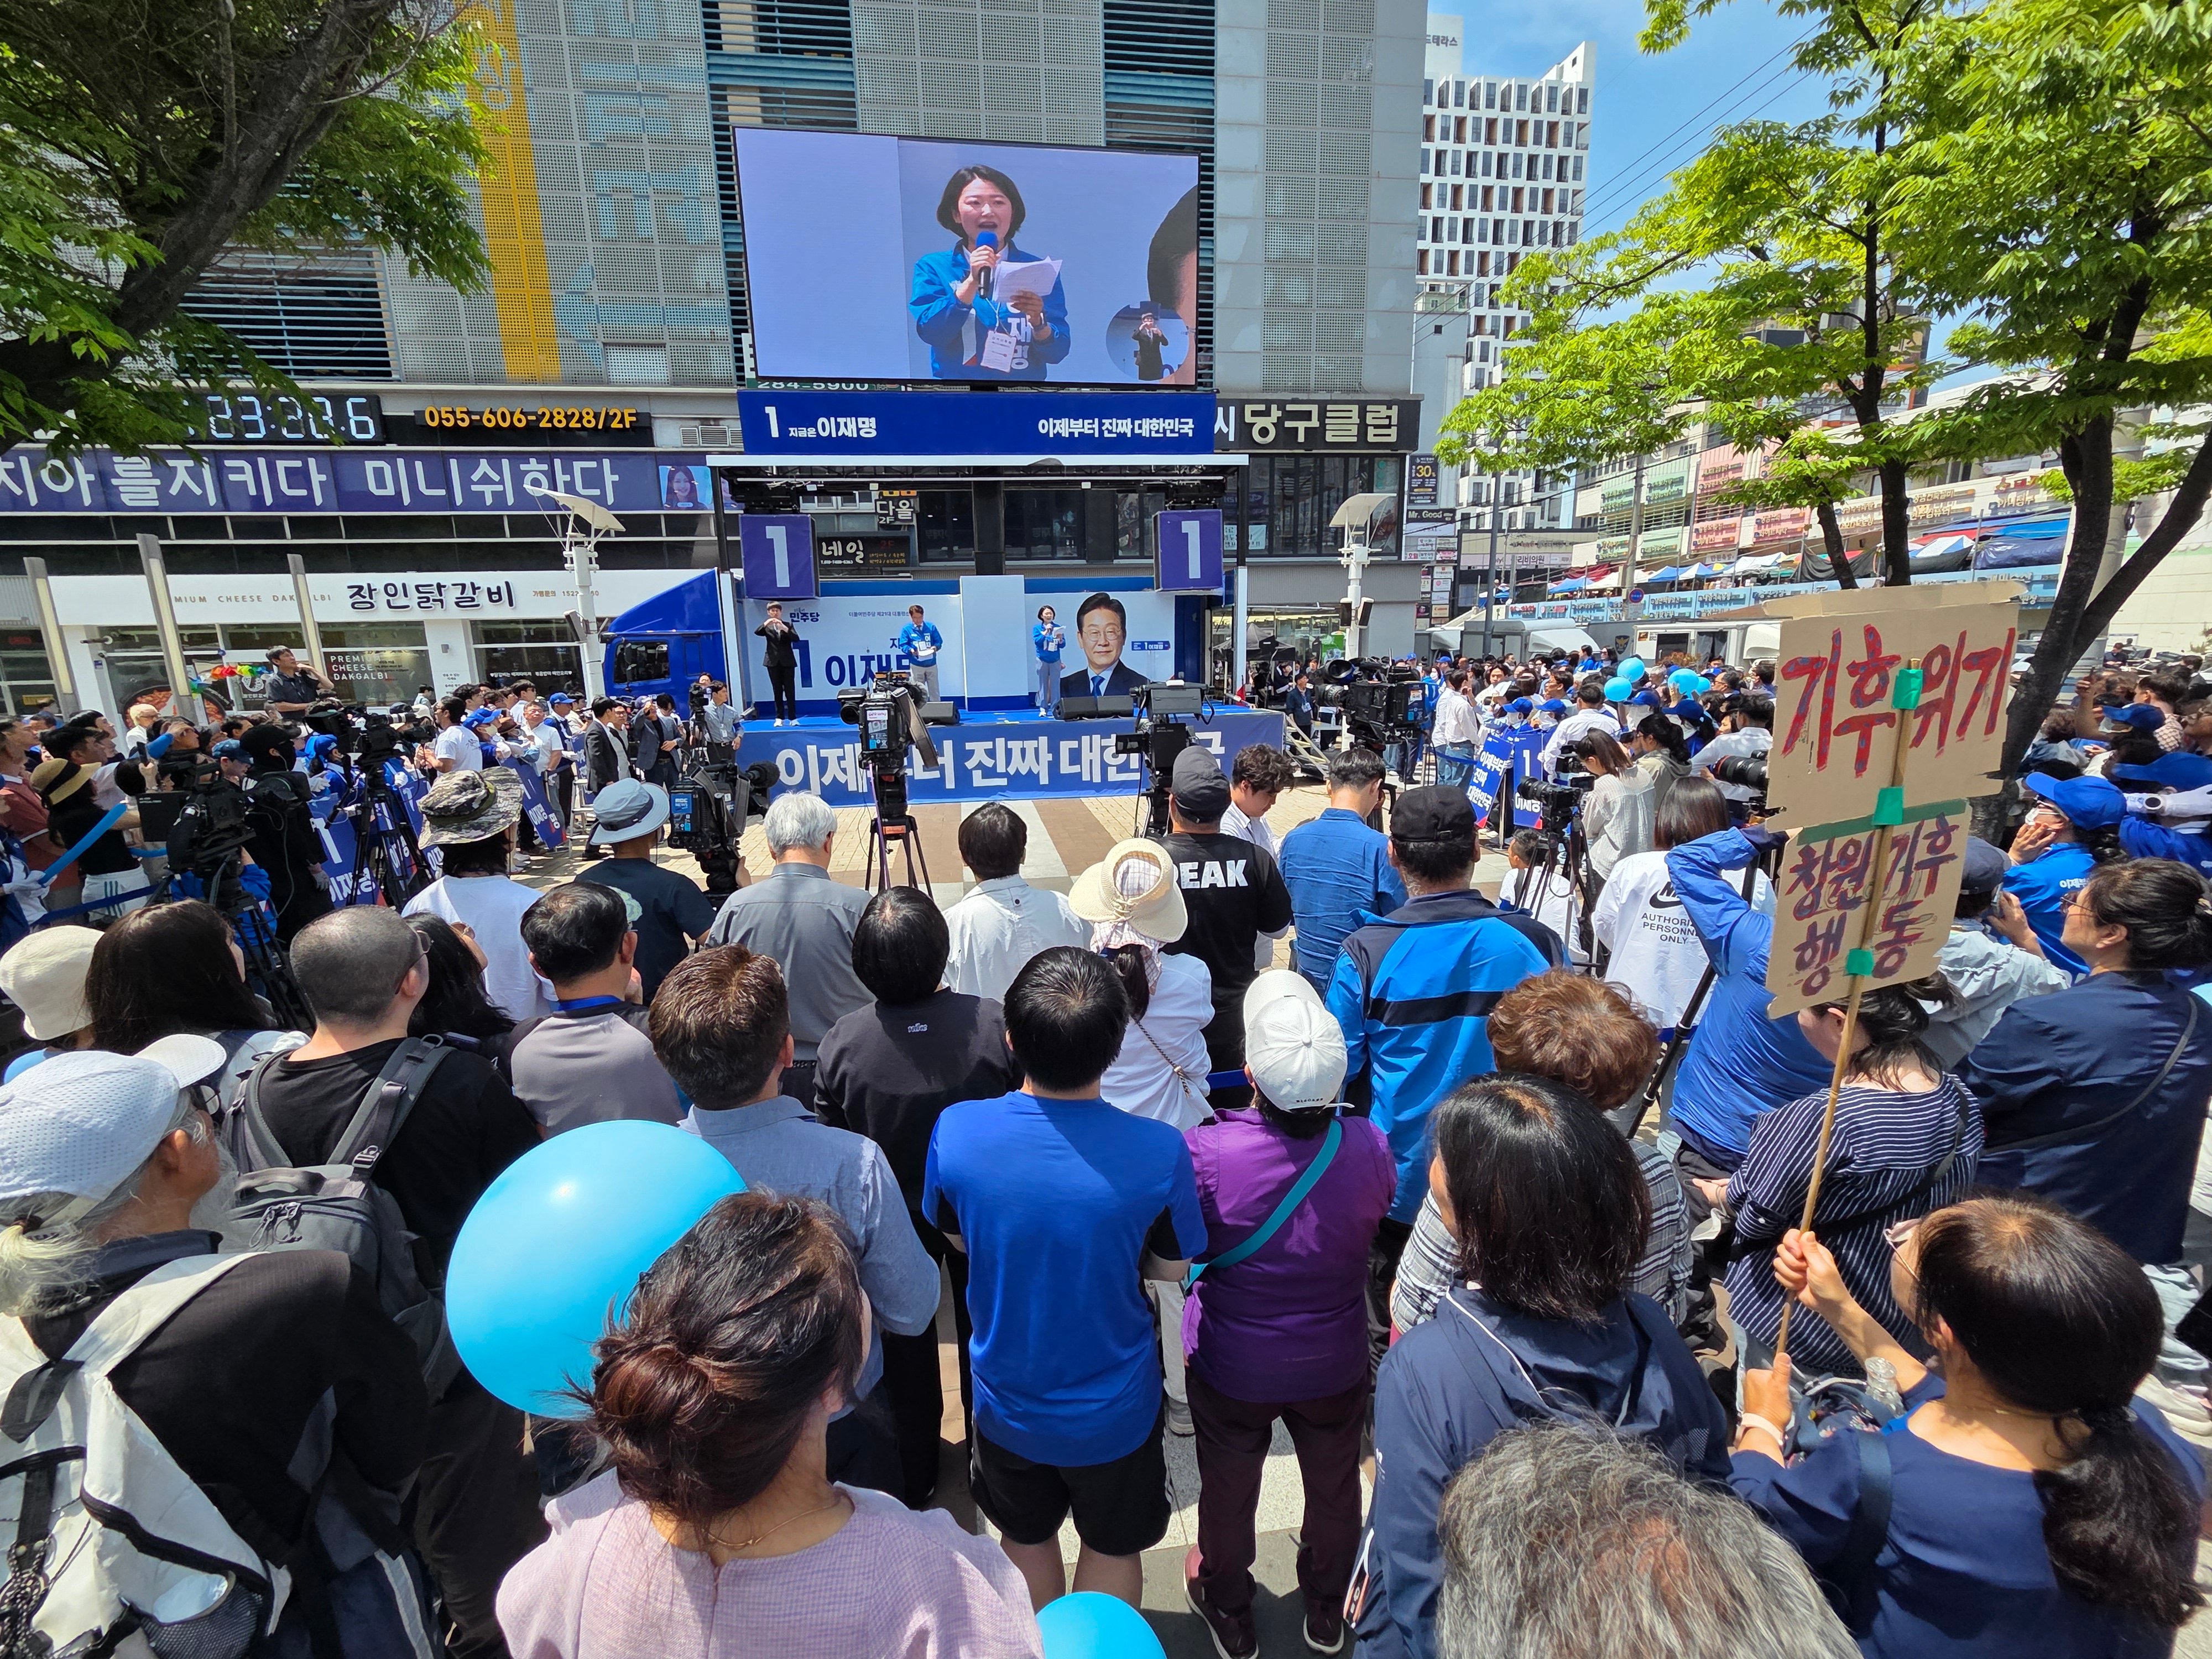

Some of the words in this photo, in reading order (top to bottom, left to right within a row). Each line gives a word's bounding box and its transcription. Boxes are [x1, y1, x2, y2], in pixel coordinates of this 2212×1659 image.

[425, 406, 637, 429] 055-606-2828/2F
[765, 406, 779, 437] 1
[789, 427, 817, 437] 지금은
[817, 416, 877, 438] 이재명
[1038, 418, 1099, 438] 이제부터
[1101, 418, 1133, 437] 진짜
[1134, 418, 1194, 437] 대한민국
[1244, 404, 1399, 444] 당구클럽
[364, 457, 619, 507] 미니쉬하다
[877, 500, 914, 519] 다올
[1408, 510, 1420, 519] Mr.
[1422, 510, 1442, 519] Good
[766, 526, 790, 587] 1
[822, 539, 864, 564] 네일
[1181, 520, 1201, 579] 1
[1516, 555, 1545, 565] 리비의원
[347, 580, 516, 611] 장인닭갈비
[790, 612, 820, 623] 민주당
[333, 672, 388, 680] DAKGALBI
[775, 739, 956, 795] 이제터
[965, 736, 1052, 787] 진짜
[1480, 751, 1507, 776] 이제부터
[1523, 750, 1530, 777] 1
[1473, 768, 1488, 787] 진짜
[1467, 785, 1493, 811] 대한민국
[1641, 912, 1693, 927] AUTHORI
[1642, 922, 1698, 936] PERSONN
[1660, 934, 1688, 945] ONLY
